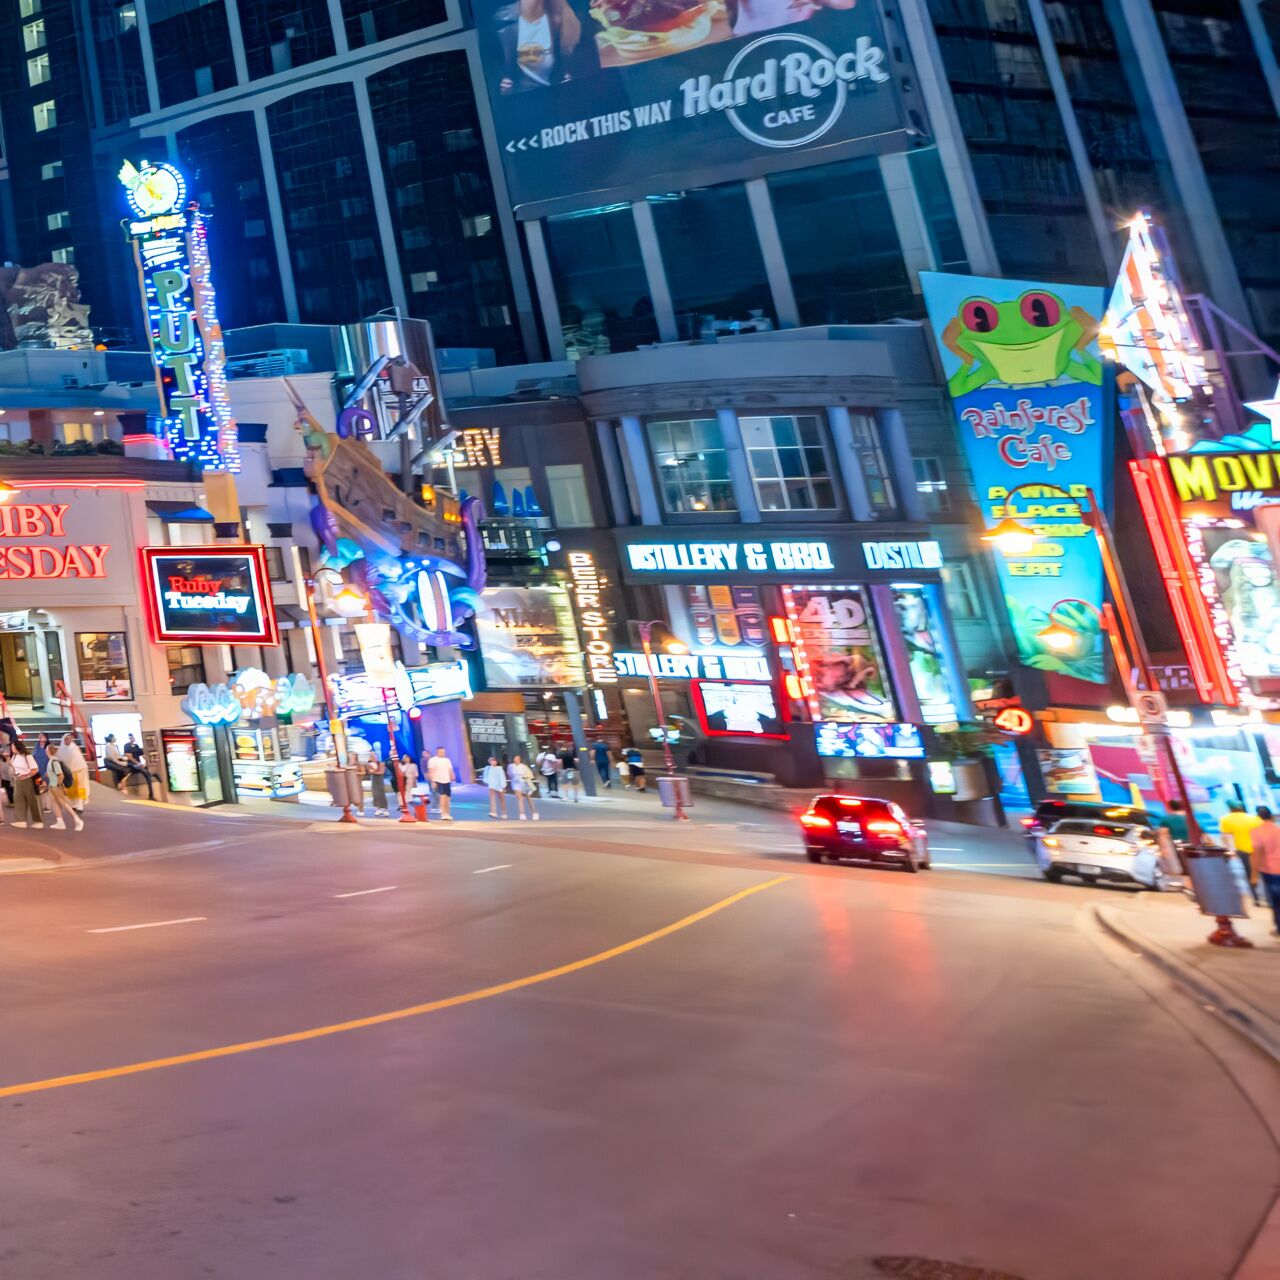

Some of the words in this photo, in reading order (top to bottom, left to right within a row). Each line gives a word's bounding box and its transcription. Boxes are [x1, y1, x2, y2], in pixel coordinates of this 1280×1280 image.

[679, 57, 780, 117] Hard
[778, 35, 890, 98] Rock
[541, 128, 589, 150] ROCK
[589, 109, 632, 139] THIS
[632, 99, 672, 130] WAY
[763, 104, 816, 130] CAFE
[961, 396, 1096, 438] Rainforest
[997, 433, 1072, 471] Cafe
[744, 542, 769, 571] &
[770, 541, 836, 571] BBQ
[164, 591, 251, 613] Tuesday
[167, 575, 222, 597] Ruby
[582, 610, 618, 683] STORE
